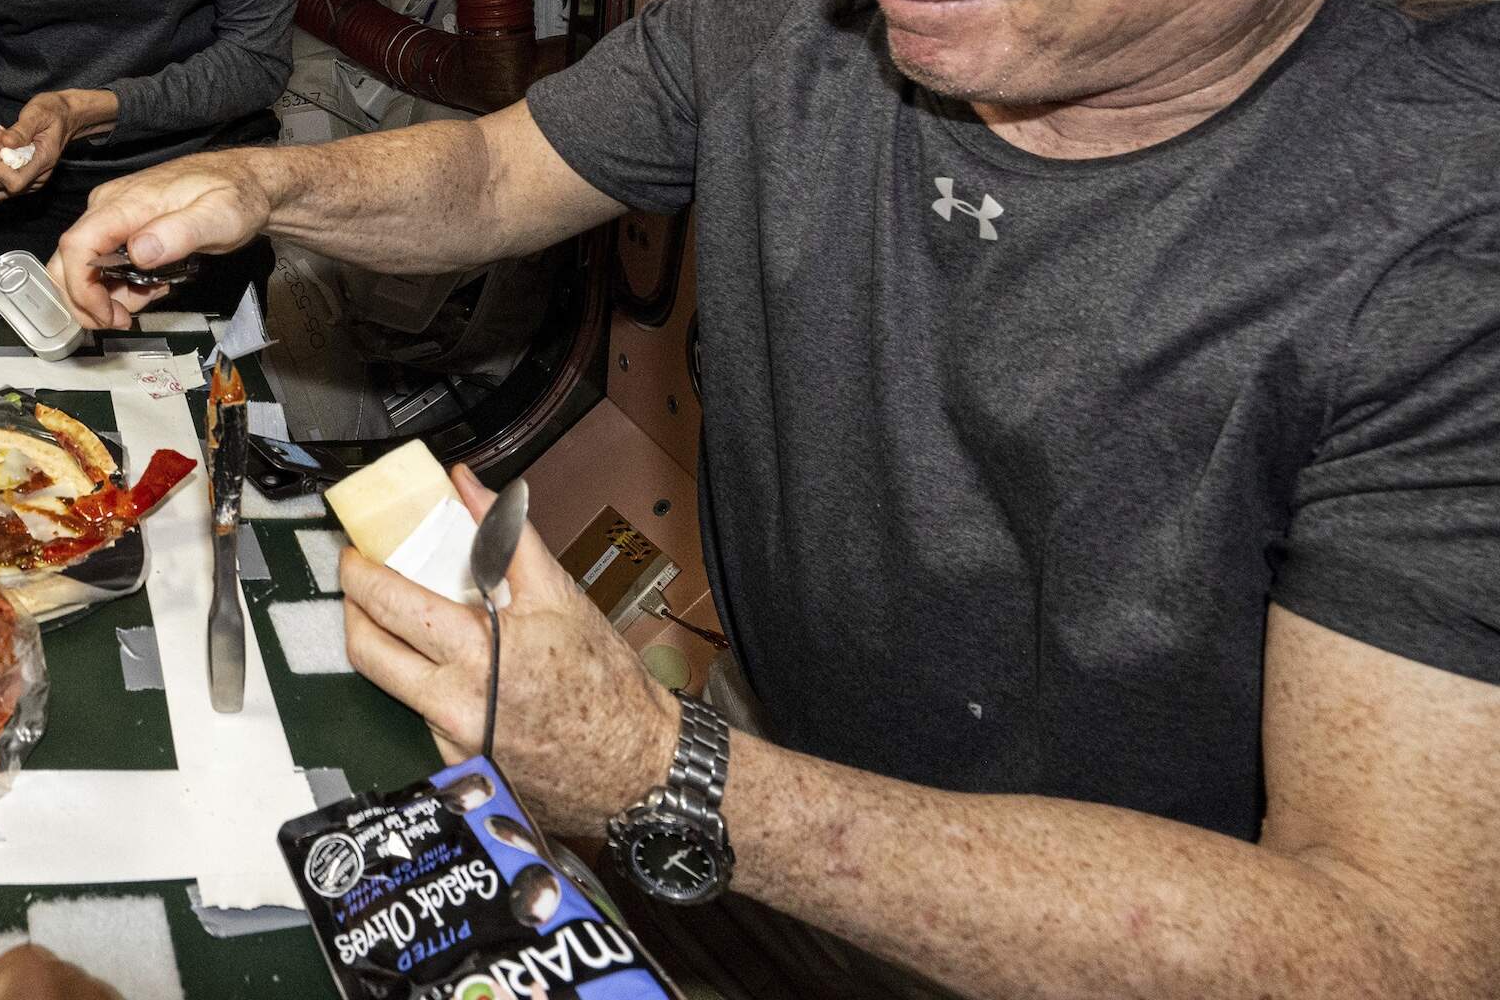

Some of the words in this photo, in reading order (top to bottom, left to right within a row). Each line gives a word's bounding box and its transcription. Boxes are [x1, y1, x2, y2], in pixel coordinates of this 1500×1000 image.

[335, 913, 346, 925] A
[408, 859, 499, 928] Snack
[333, 900, 415, 966] Olives
[397, 918, 473, 972] PITTED
